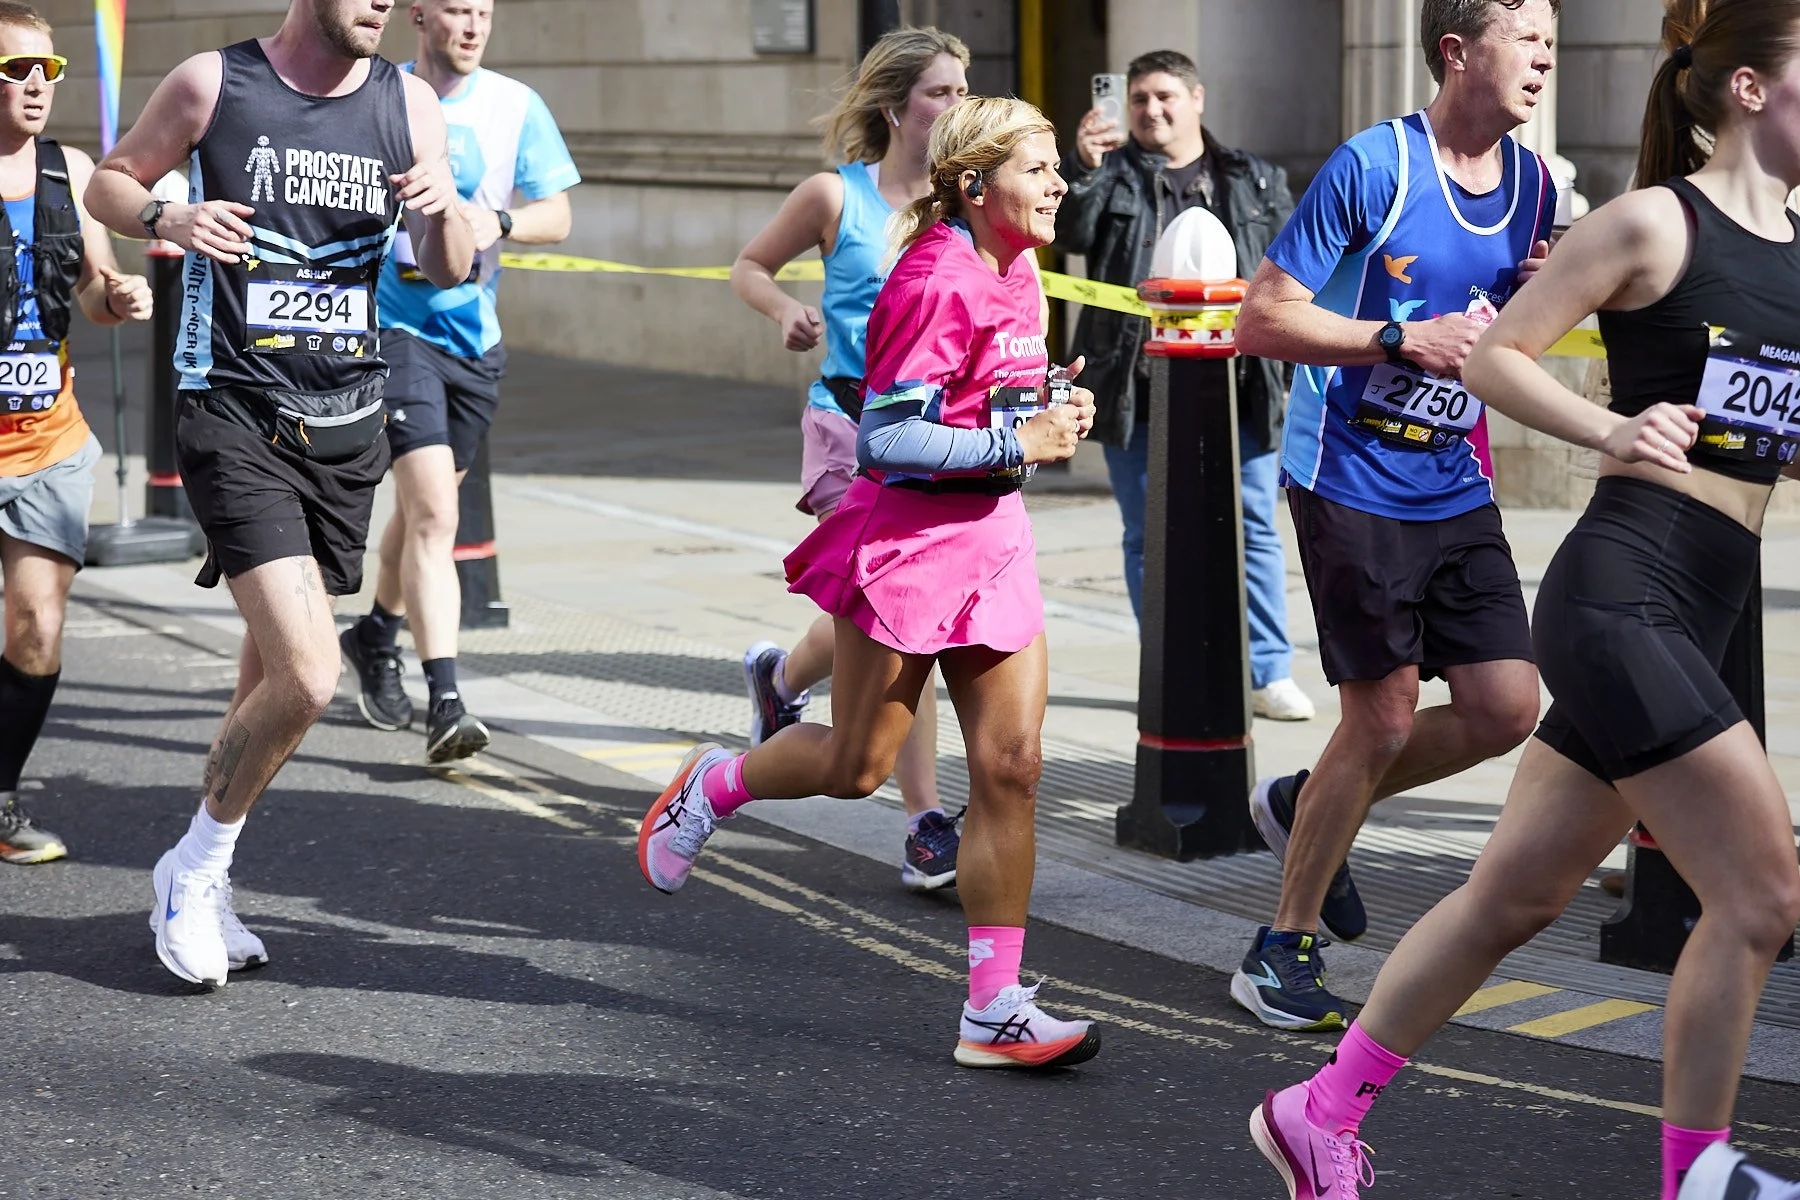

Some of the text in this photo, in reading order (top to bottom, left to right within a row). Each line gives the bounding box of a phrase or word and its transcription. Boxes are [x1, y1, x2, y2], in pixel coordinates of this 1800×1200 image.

[285, 148, 384, 187] PROSTATE
[284, 176, 388, 216] CANCER UK
[296, 268, 333, 280] ASHLEY
[186, 294, 200, 348] CNCER
[268, 290, 352, 324] 2294
[0, 361, 48, 386] 202
[183, 351, 197, 369] UK
[1383, 374, 1469, 421] 2750
